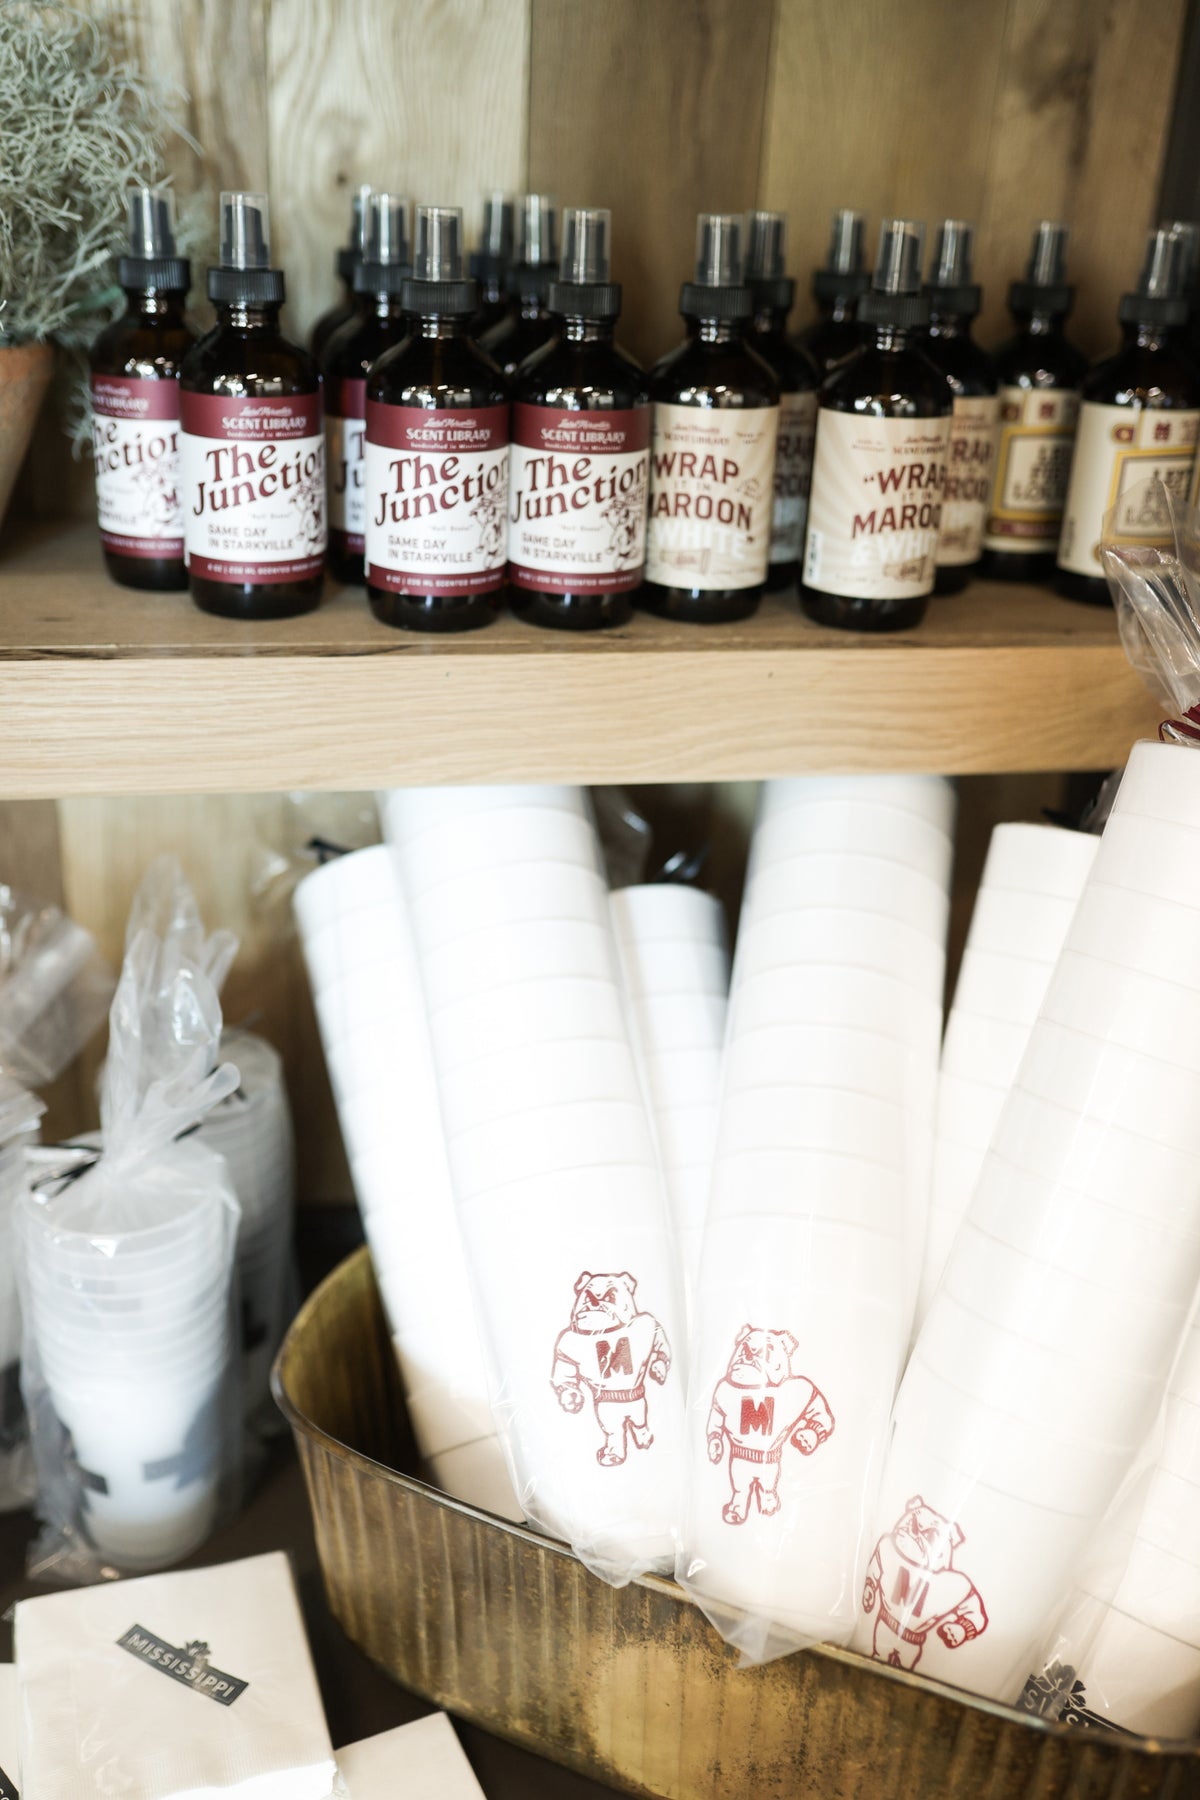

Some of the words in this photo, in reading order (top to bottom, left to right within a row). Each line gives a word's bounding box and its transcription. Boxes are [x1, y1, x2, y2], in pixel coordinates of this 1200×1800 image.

[92, 419, 118, 448] he
[222, 416, 261, 430] SCENT
[262, 416, 307, 431] LIBRARY
[405, 428, 444, 441] SCENT
[446, 429, 491, 443] LIBRARY
[540, 428, 577, 442] SCENT
[579, 431, 626, 445] LIBRARY
[95, 431, 179, 477] nctio
[205, 444, 278, 483] The
[652, 451, 740, 485] WRAP
[389, 455, 460, 494] The
[525, 455, 592, 492] The
[388, 549, 399, 559] IN
[402, 551, 473, 563] STARKVILLE
[423, 539, 448, 550] DAY
[739, 1396, 776, 1436] M
[126, 1632, 236, 1698] MISSISSIPPI
